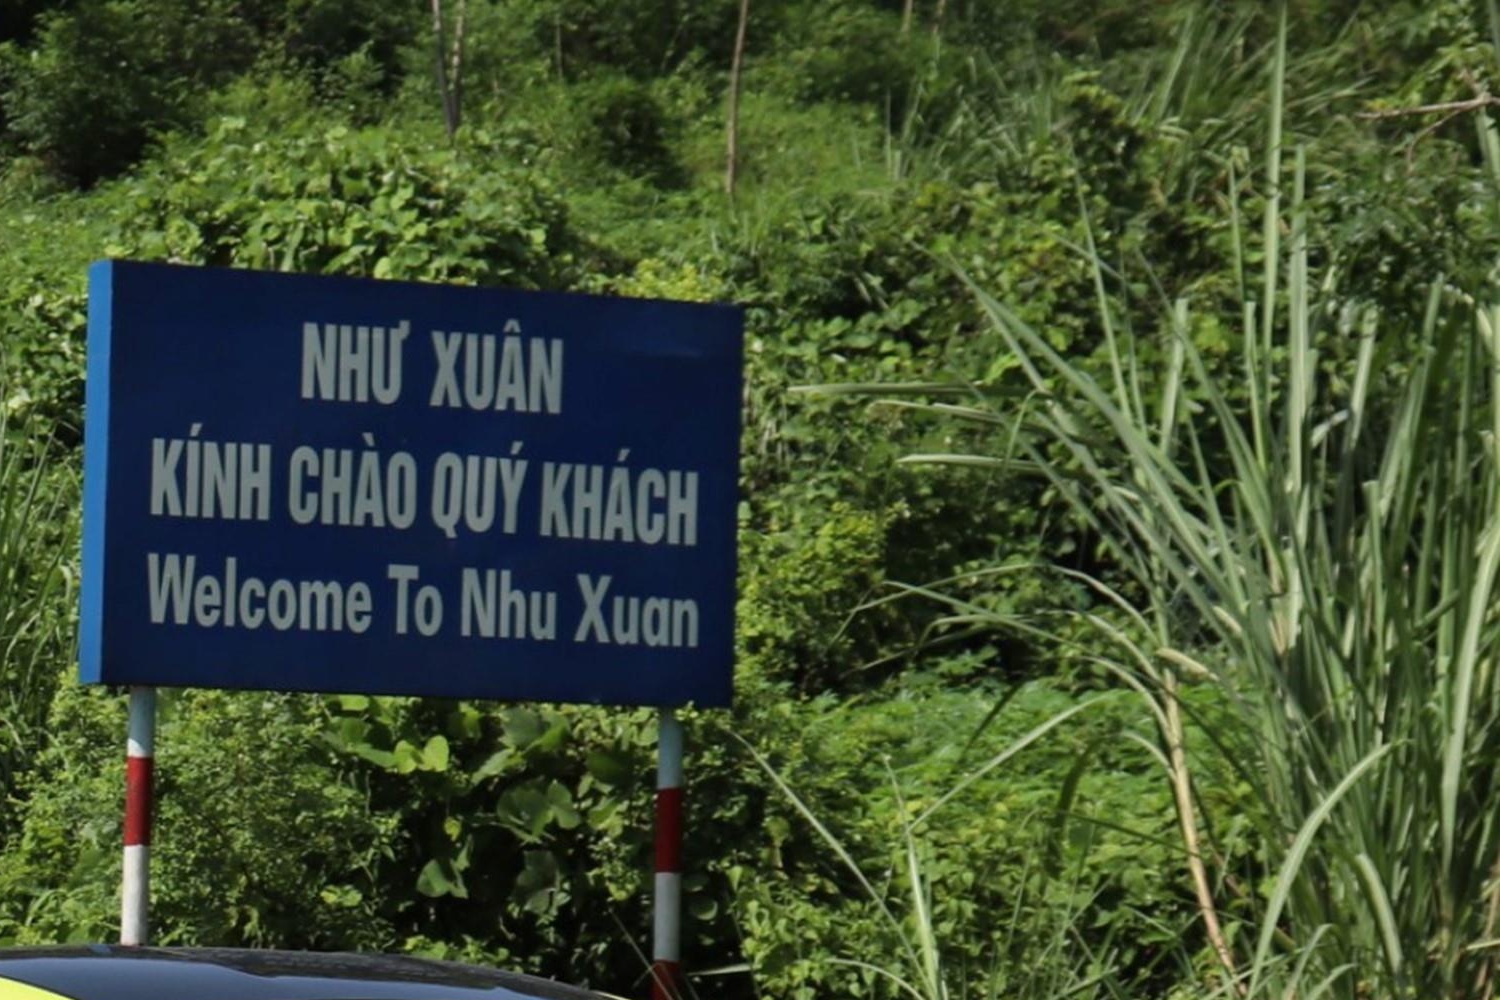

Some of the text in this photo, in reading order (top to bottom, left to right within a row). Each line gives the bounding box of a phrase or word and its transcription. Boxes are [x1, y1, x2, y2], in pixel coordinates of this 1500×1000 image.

[301, 318, 563, 414] NHƯ XUÂN
[150, 422, 698, 546] KÍNH CHÀO QUÝ KHÁCH
[147, 552, 698, 648] Welcome To Nhu Xuan
